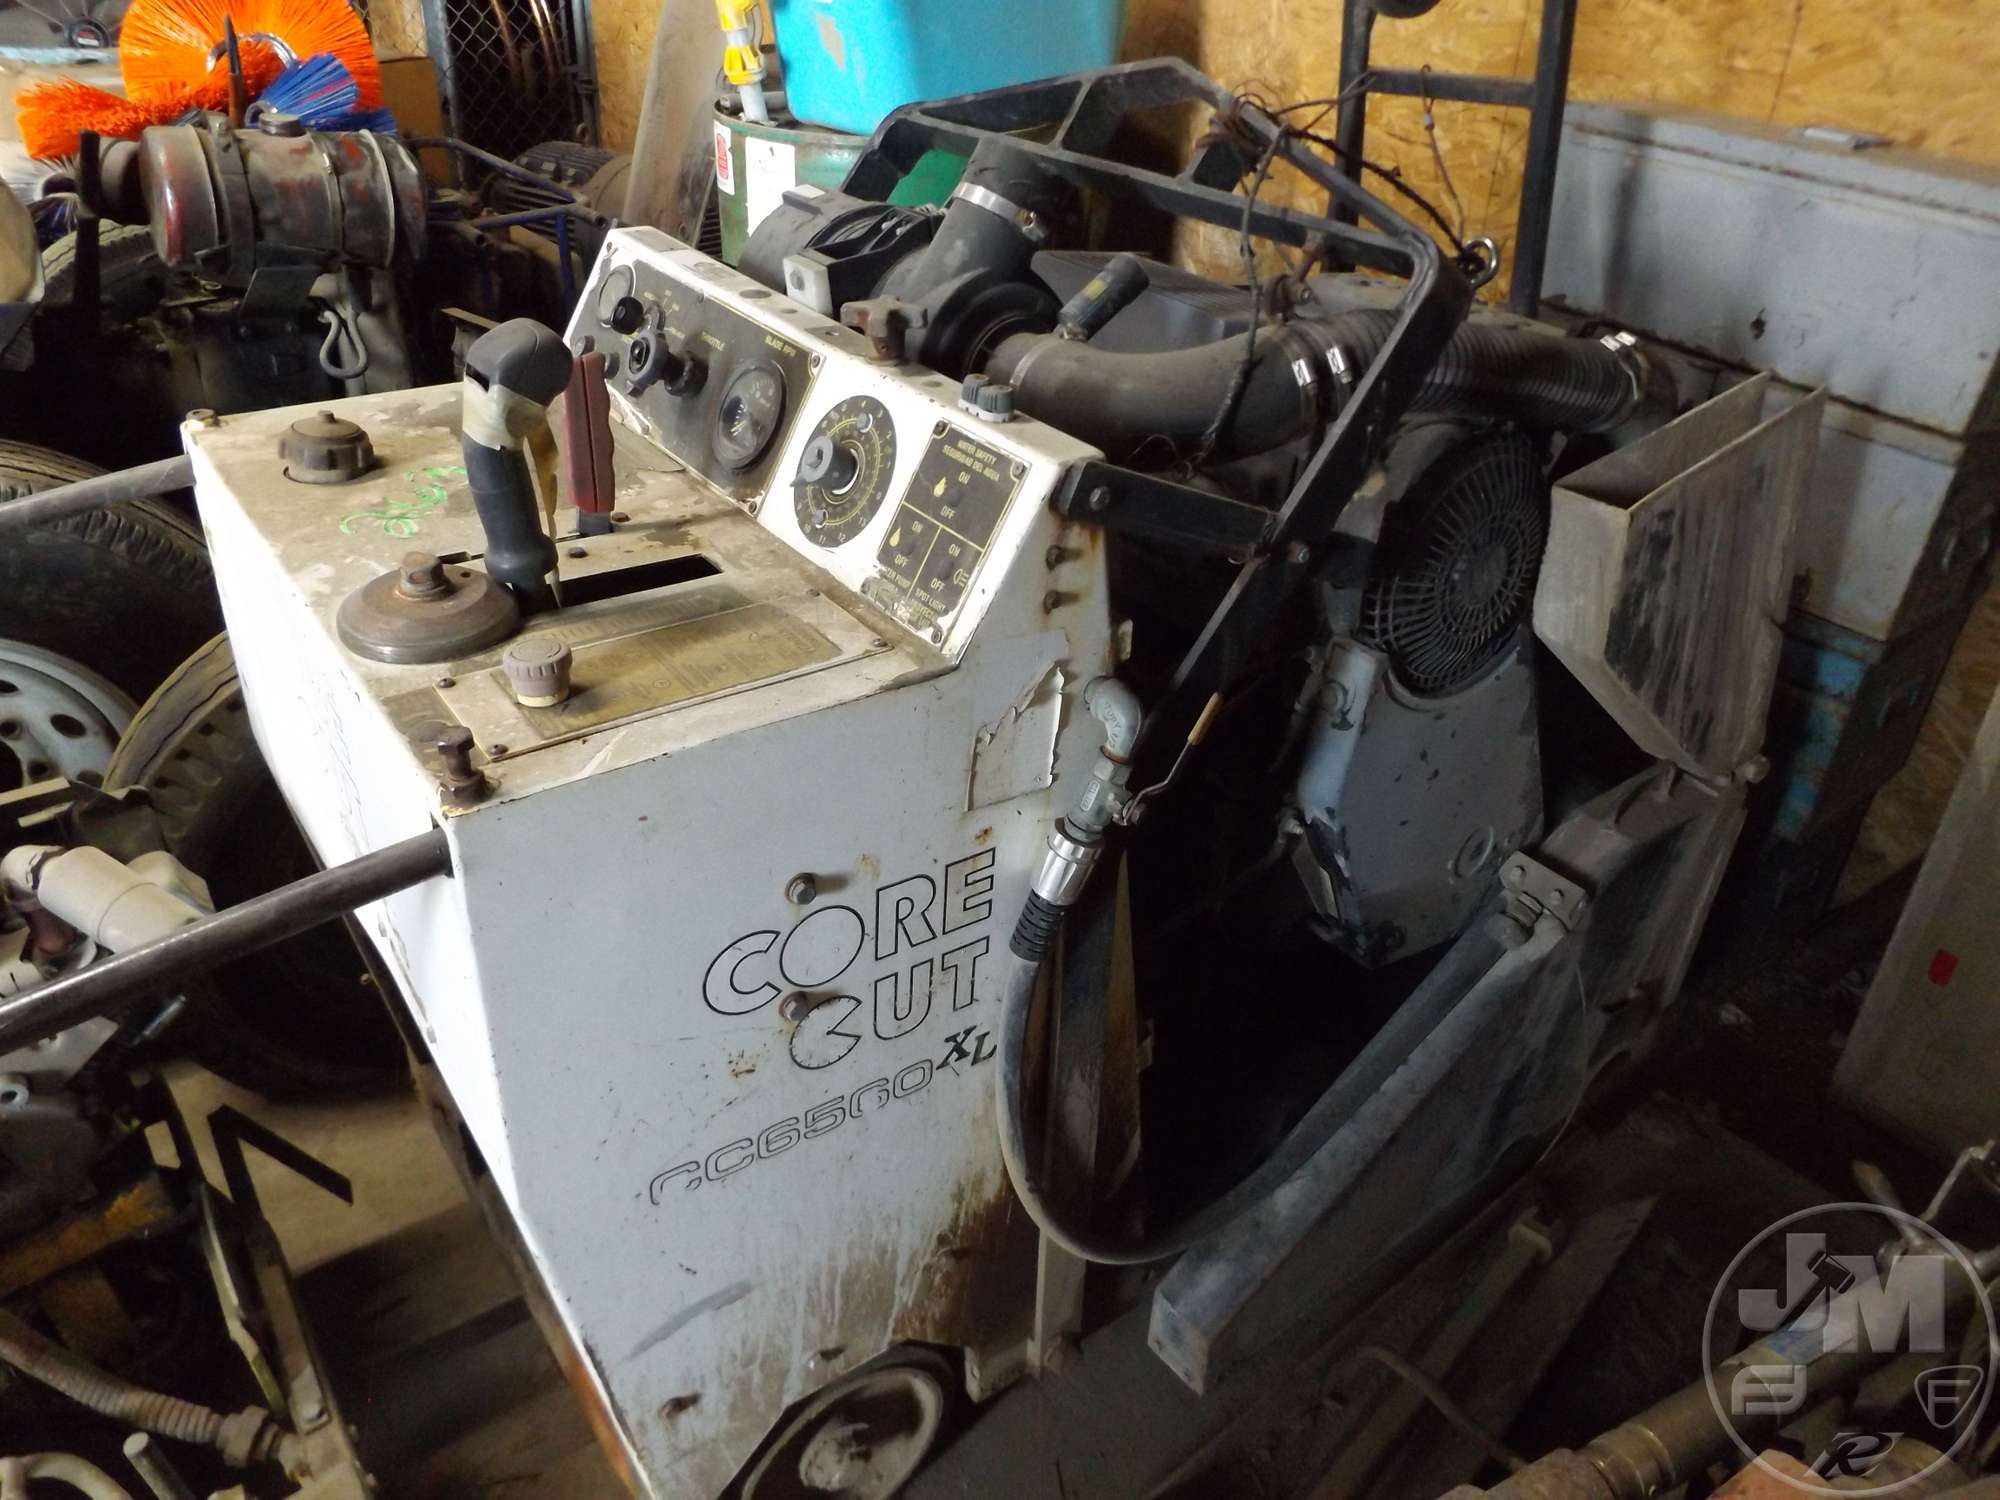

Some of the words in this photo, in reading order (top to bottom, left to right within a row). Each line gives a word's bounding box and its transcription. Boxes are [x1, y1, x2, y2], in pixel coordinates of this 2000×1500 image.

[959, 471, 971, 485] ON
[940, 505, 956, 519] OFF
[912, 520, 923, 533] ON
[948, 543, 960, 558] ON
[894, 554, 908, 567] OFF
[930, 577, 946, 592] OFF
[915, 588, 930, 601] SPOT
[929, 598, 946, 611] LIGHT
[703, 847, 996, 1016] CORE
[789, 935, 990, 1070] CUT
